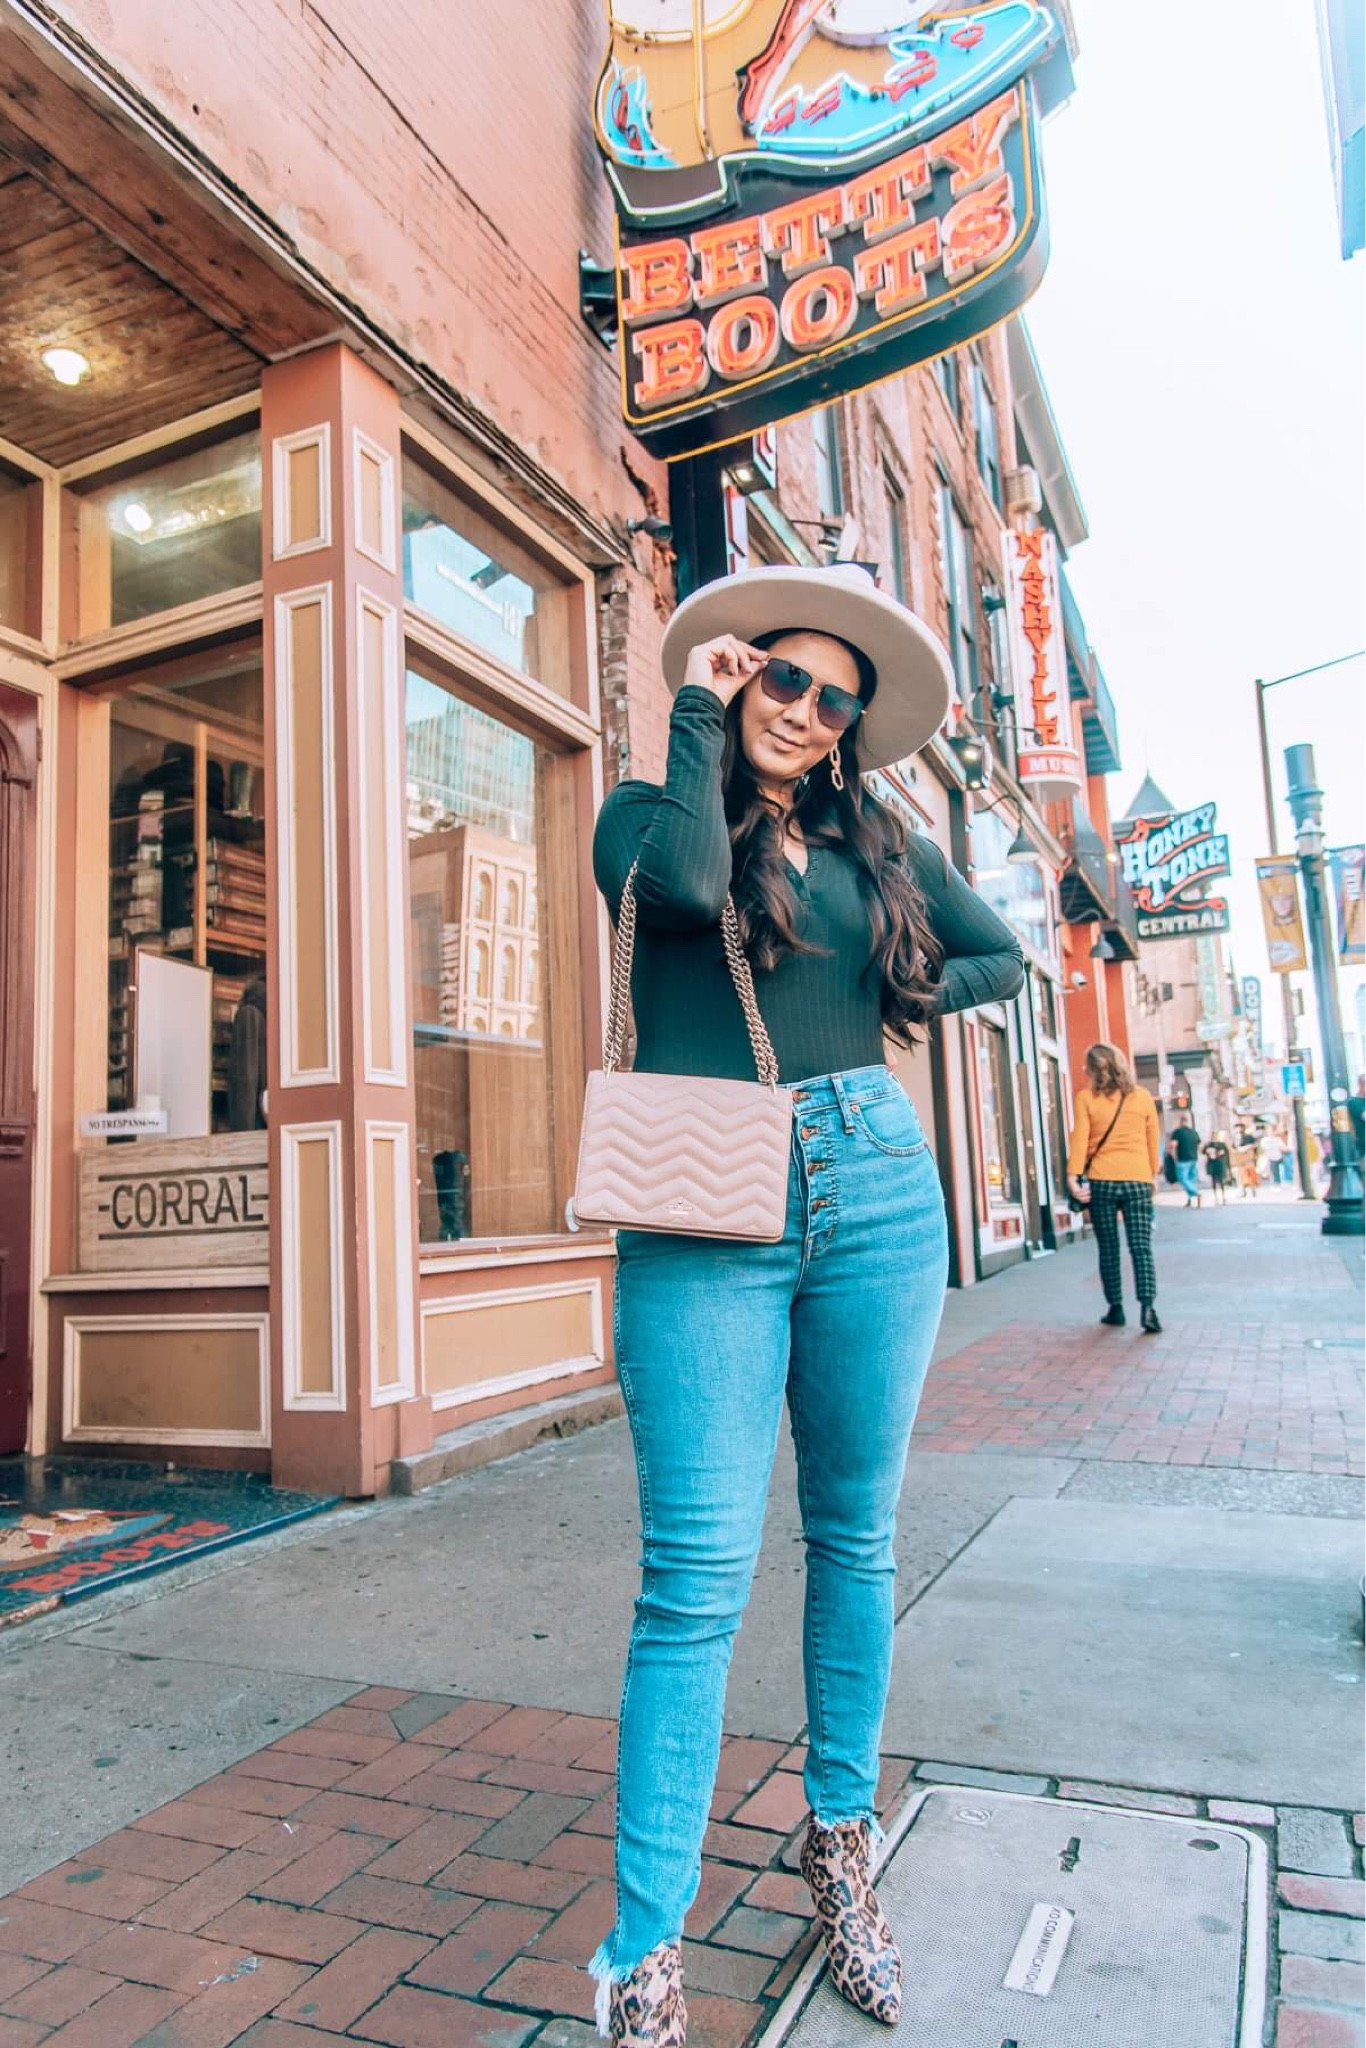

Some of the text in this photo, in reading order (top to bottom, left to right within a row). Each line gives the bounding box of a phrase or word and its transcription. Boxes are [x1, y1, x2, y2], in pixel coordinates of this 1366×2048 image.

[619, 89, 1020, 325] BETTY
[631, 173, 1017, 410] BOOTS
[1015, 527, 1059, 746] NASHVILLE
[1120, 803, 1216, 884] HONKY
[1141, 836, 1228, 907] TONK
[1137, 910, 1226, 936] CENTRAL
[112, 1175, 264, 1230] CORRAL
[8, 1519, 231, 1593] BOOTS
